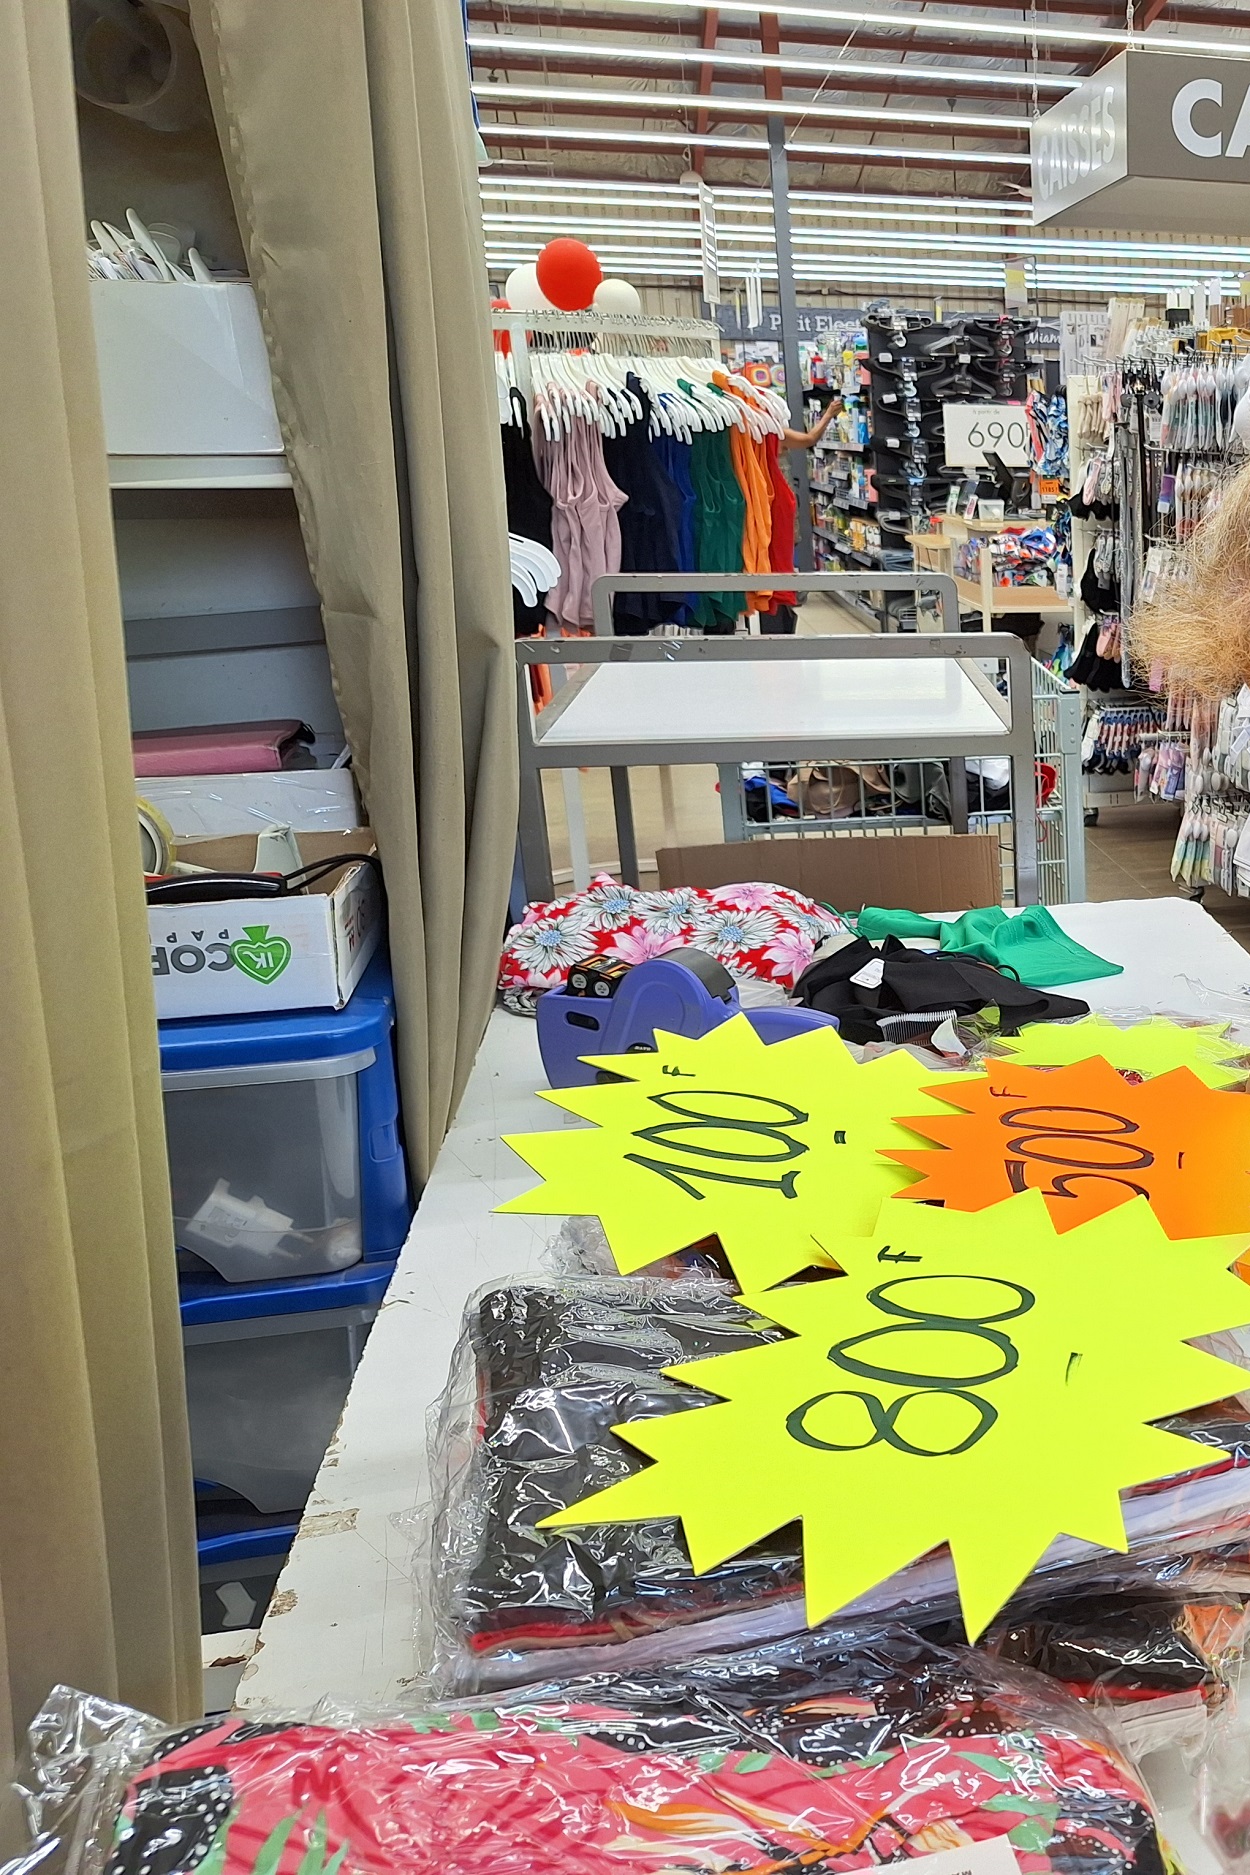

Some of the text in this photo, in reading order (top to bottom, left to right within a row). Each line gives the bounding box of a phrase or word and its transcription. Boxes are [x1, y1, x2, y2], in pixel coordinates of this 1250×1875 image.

[1038, 85, 1115, 200] CAISSES
[623, 1090, 810, 1201] 100
[1001, 1106, 1155, 1202] 500
[785, 1274, 1036, 1457] 800
